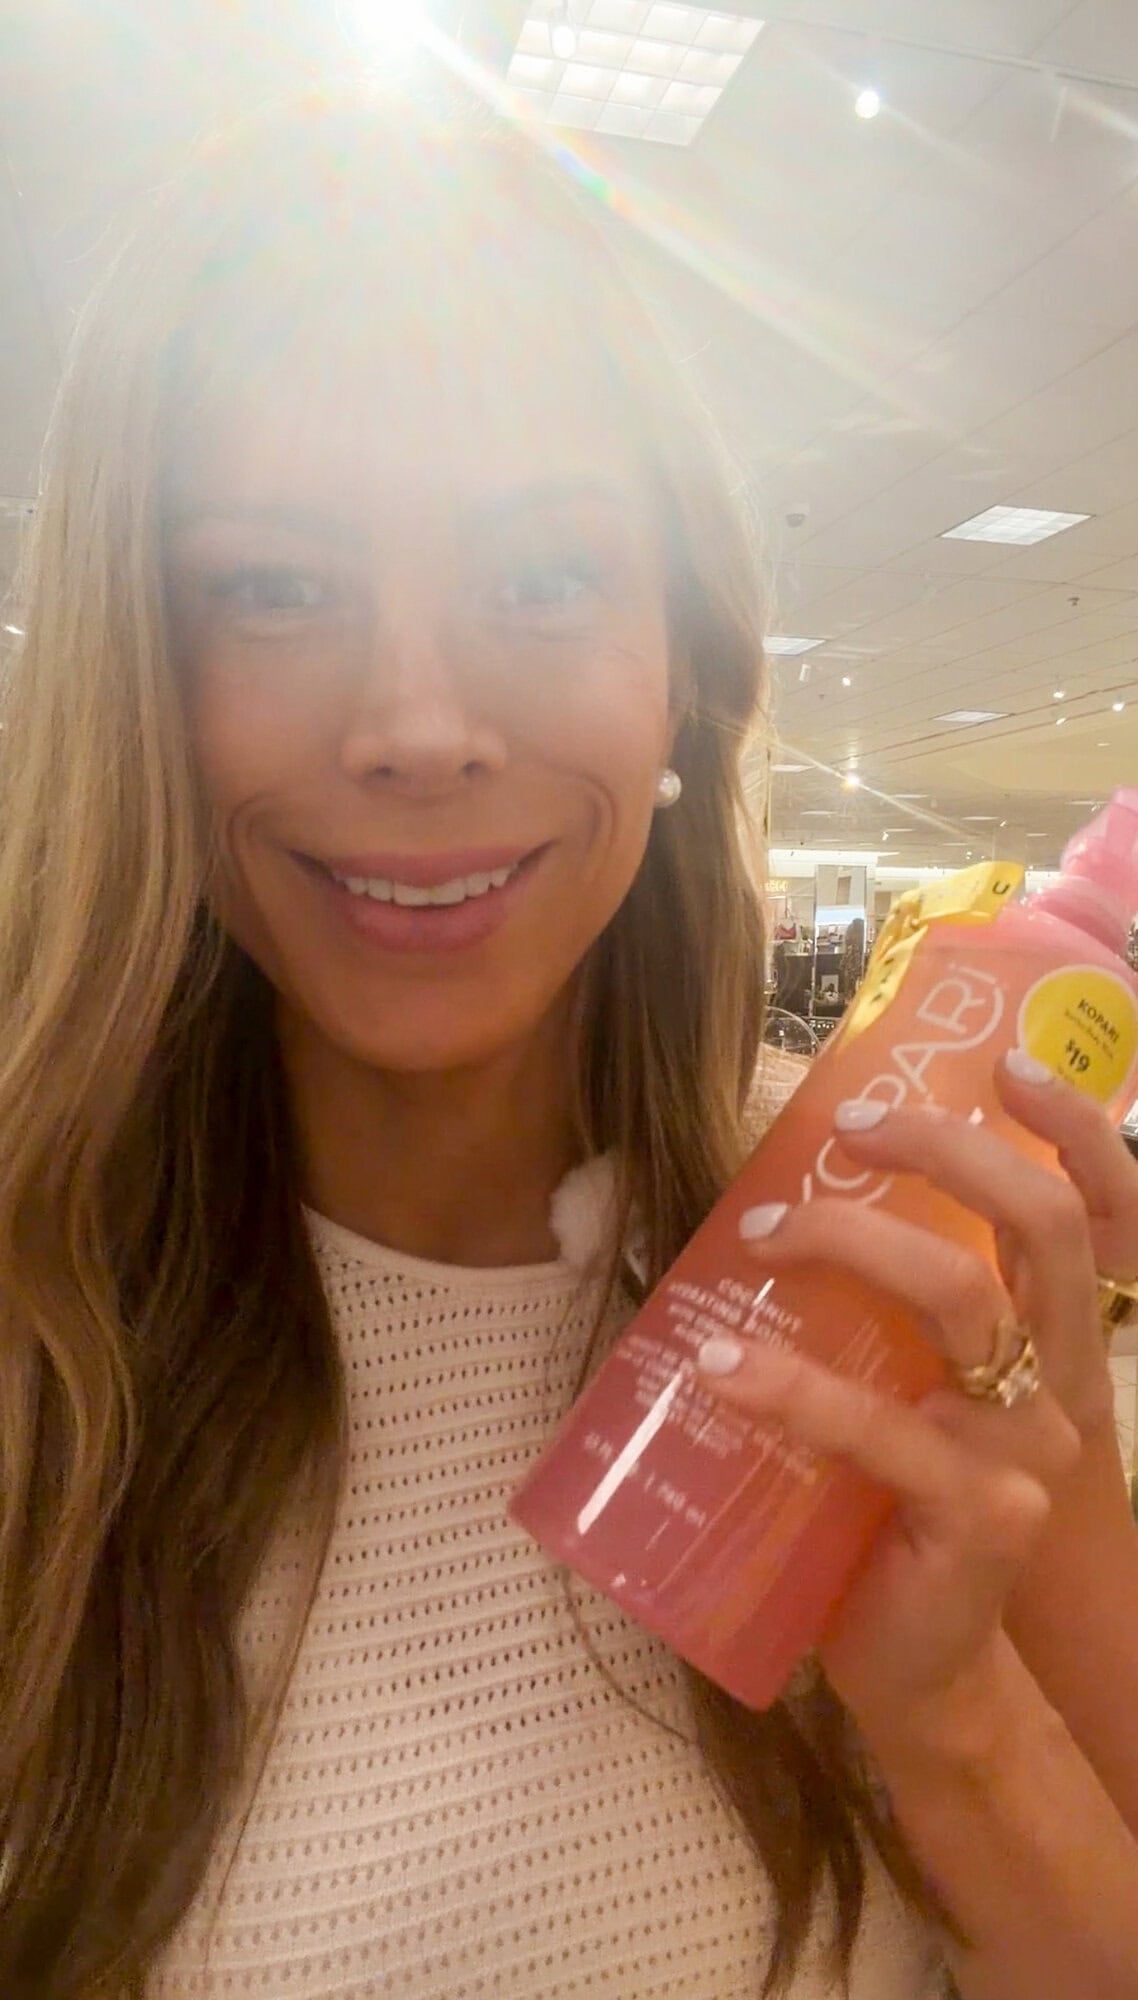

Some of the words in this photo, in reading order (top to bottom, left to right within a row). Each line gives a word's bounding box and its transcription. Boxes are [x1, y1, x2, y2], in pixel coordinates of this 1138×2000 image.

[1077, 998, 1119, 1044] KOPARI
[1065, 1038, 1090, 1073] $19
[718, 1278, 802, 1333] COCNUT
